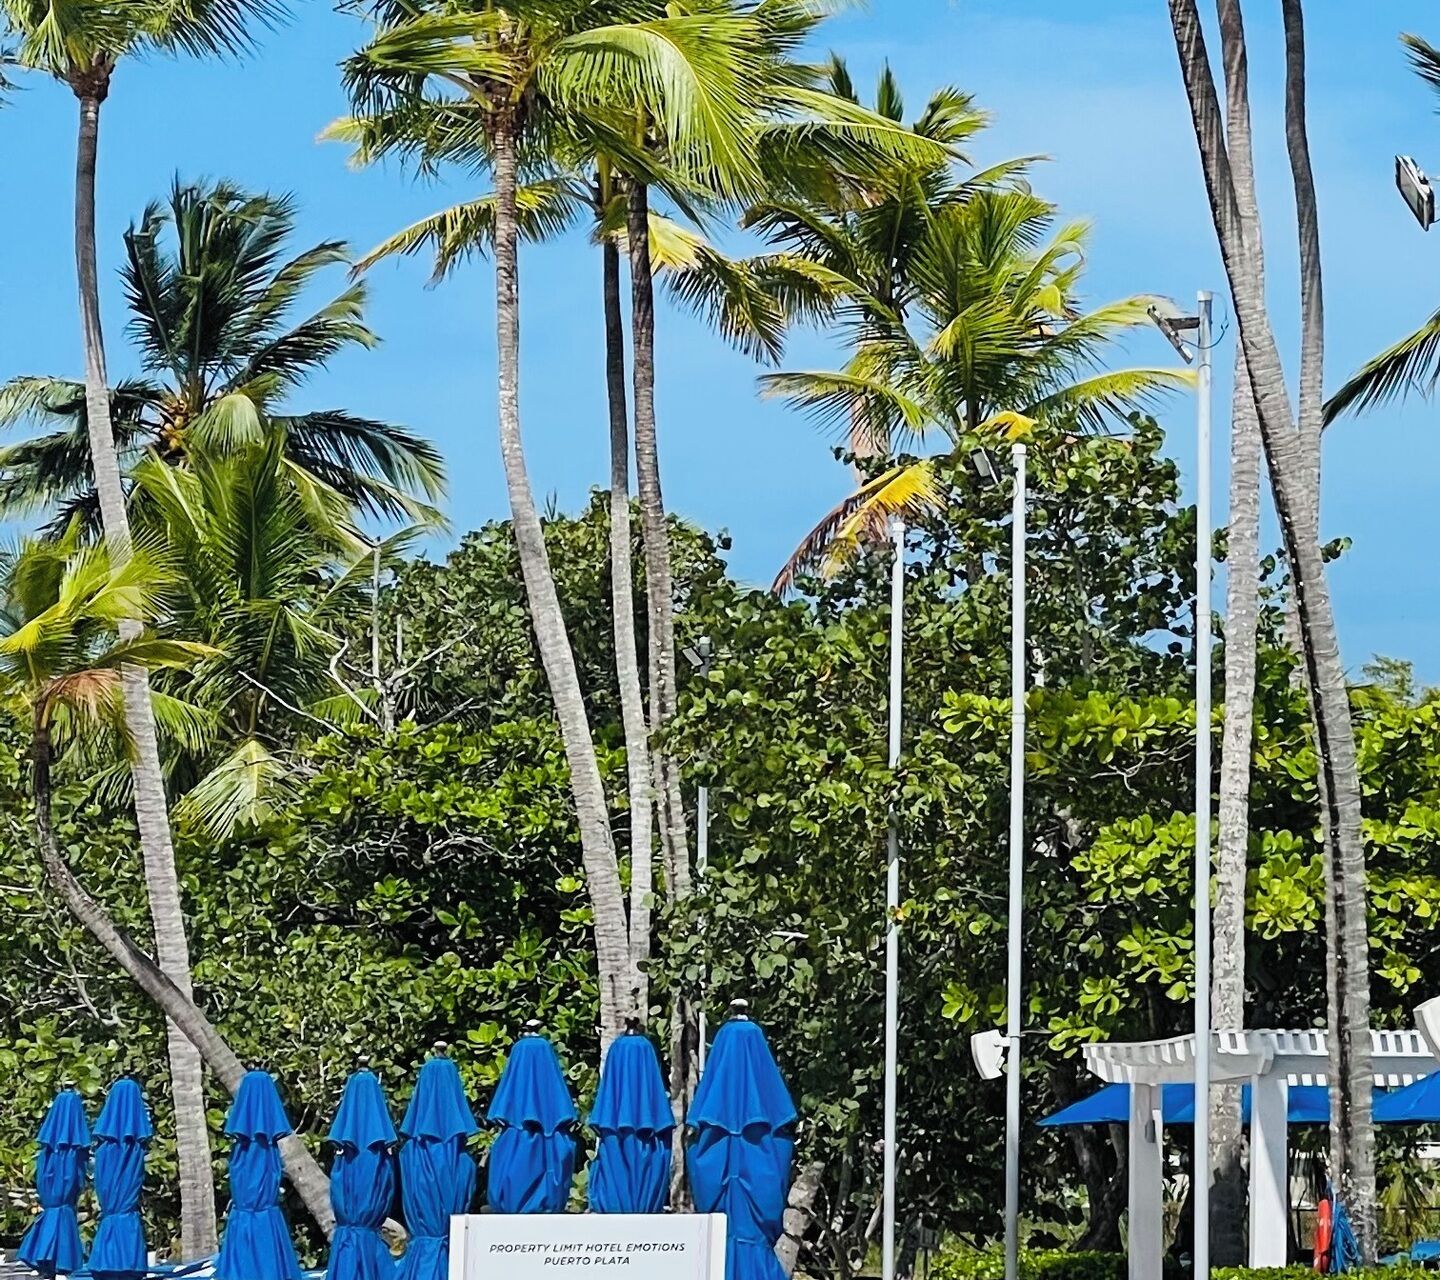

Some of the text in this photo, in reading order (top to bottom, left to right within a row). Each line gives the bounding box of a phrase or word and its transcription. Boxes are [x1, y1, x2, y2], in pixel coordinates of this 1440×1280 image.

[489, 1241, 686, 1254] PROPERTY LIMIT HOTEL EMOTIONS
[544, 1256, 631, 1266] PUERTO PLATA
